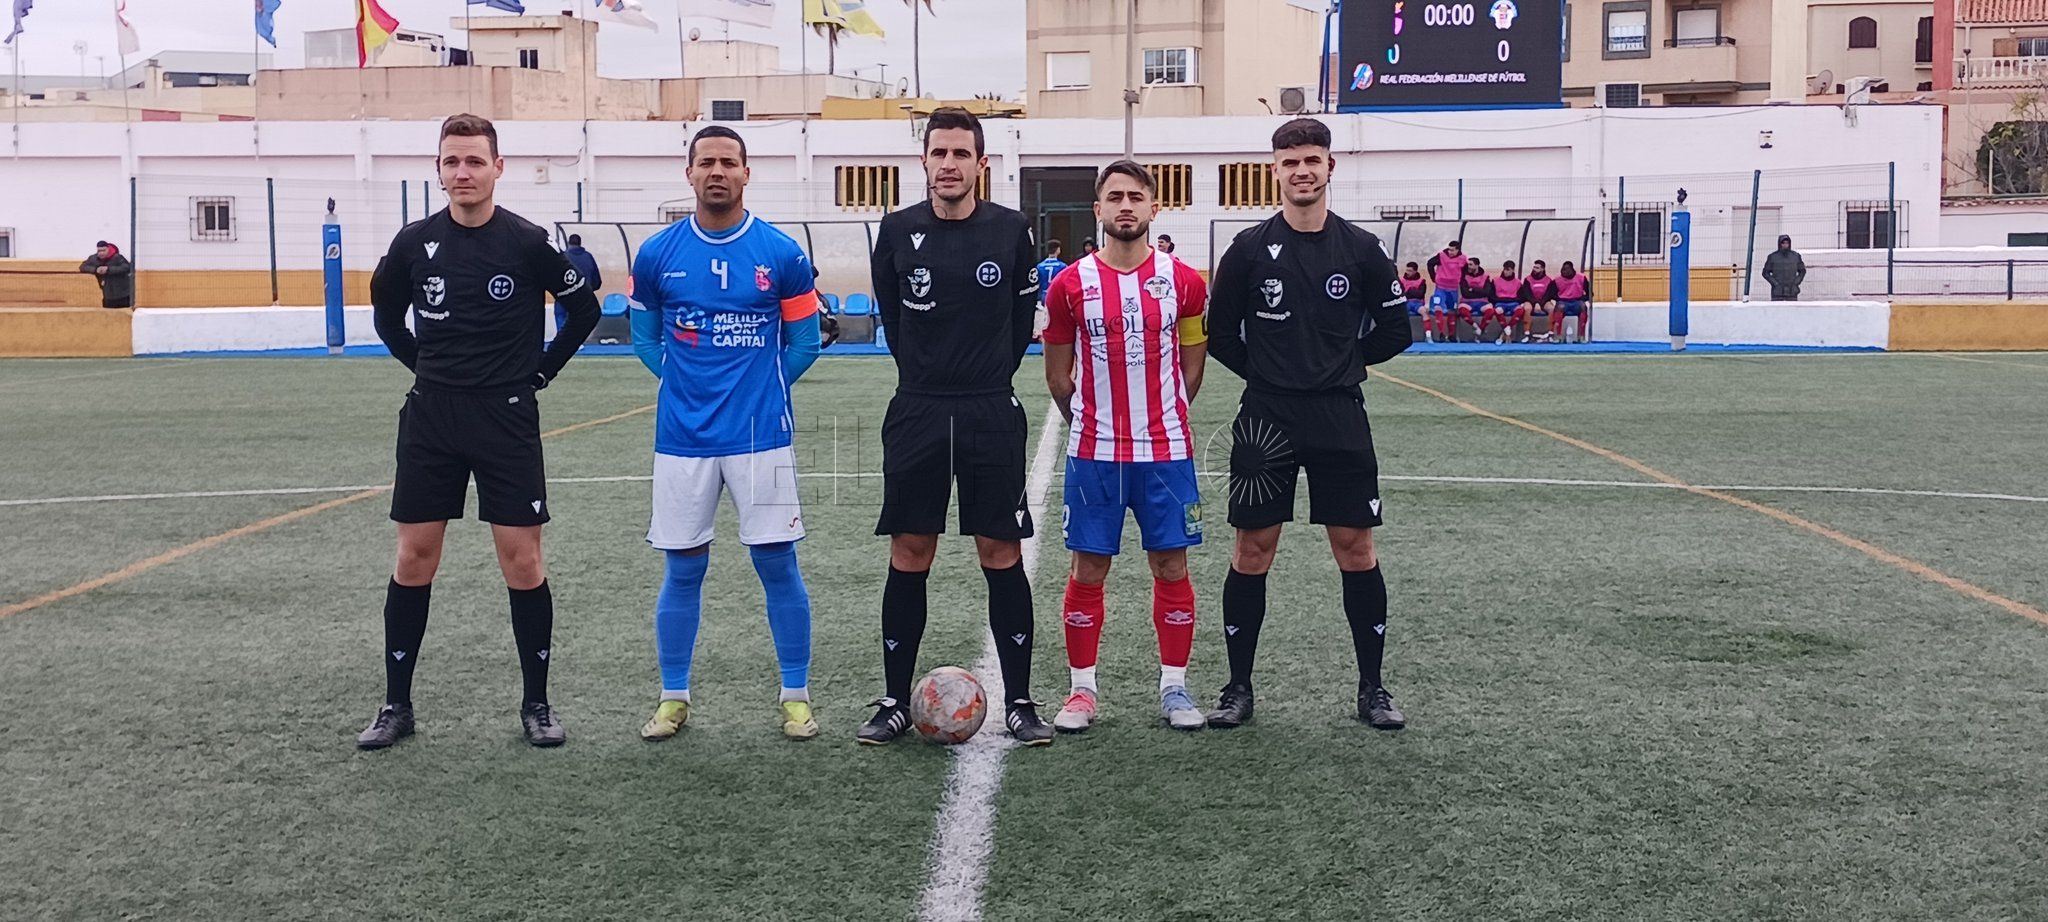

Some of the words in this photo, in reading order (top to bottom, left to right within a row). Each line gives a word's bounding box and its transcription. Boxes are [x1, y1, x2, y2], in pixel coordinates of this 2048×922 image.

[1424, 3, 1475, 26] 00:00
[1497, 40, 1509, 62] 0
[1379, 73, 1398, 84] REAL
[1398, 71, 1444, 84] FEDERACIÓN
[1444, 72, 1488, 82] MELILLENSE
[1488, 71, 1499, 82] DE
[1499, 70, 1526, 82] FÚTBOL
[711, 258, 729, 290] 4
[713, 313, 769, 324] MELILLA
[712, 323, 760, 335] SPORT
